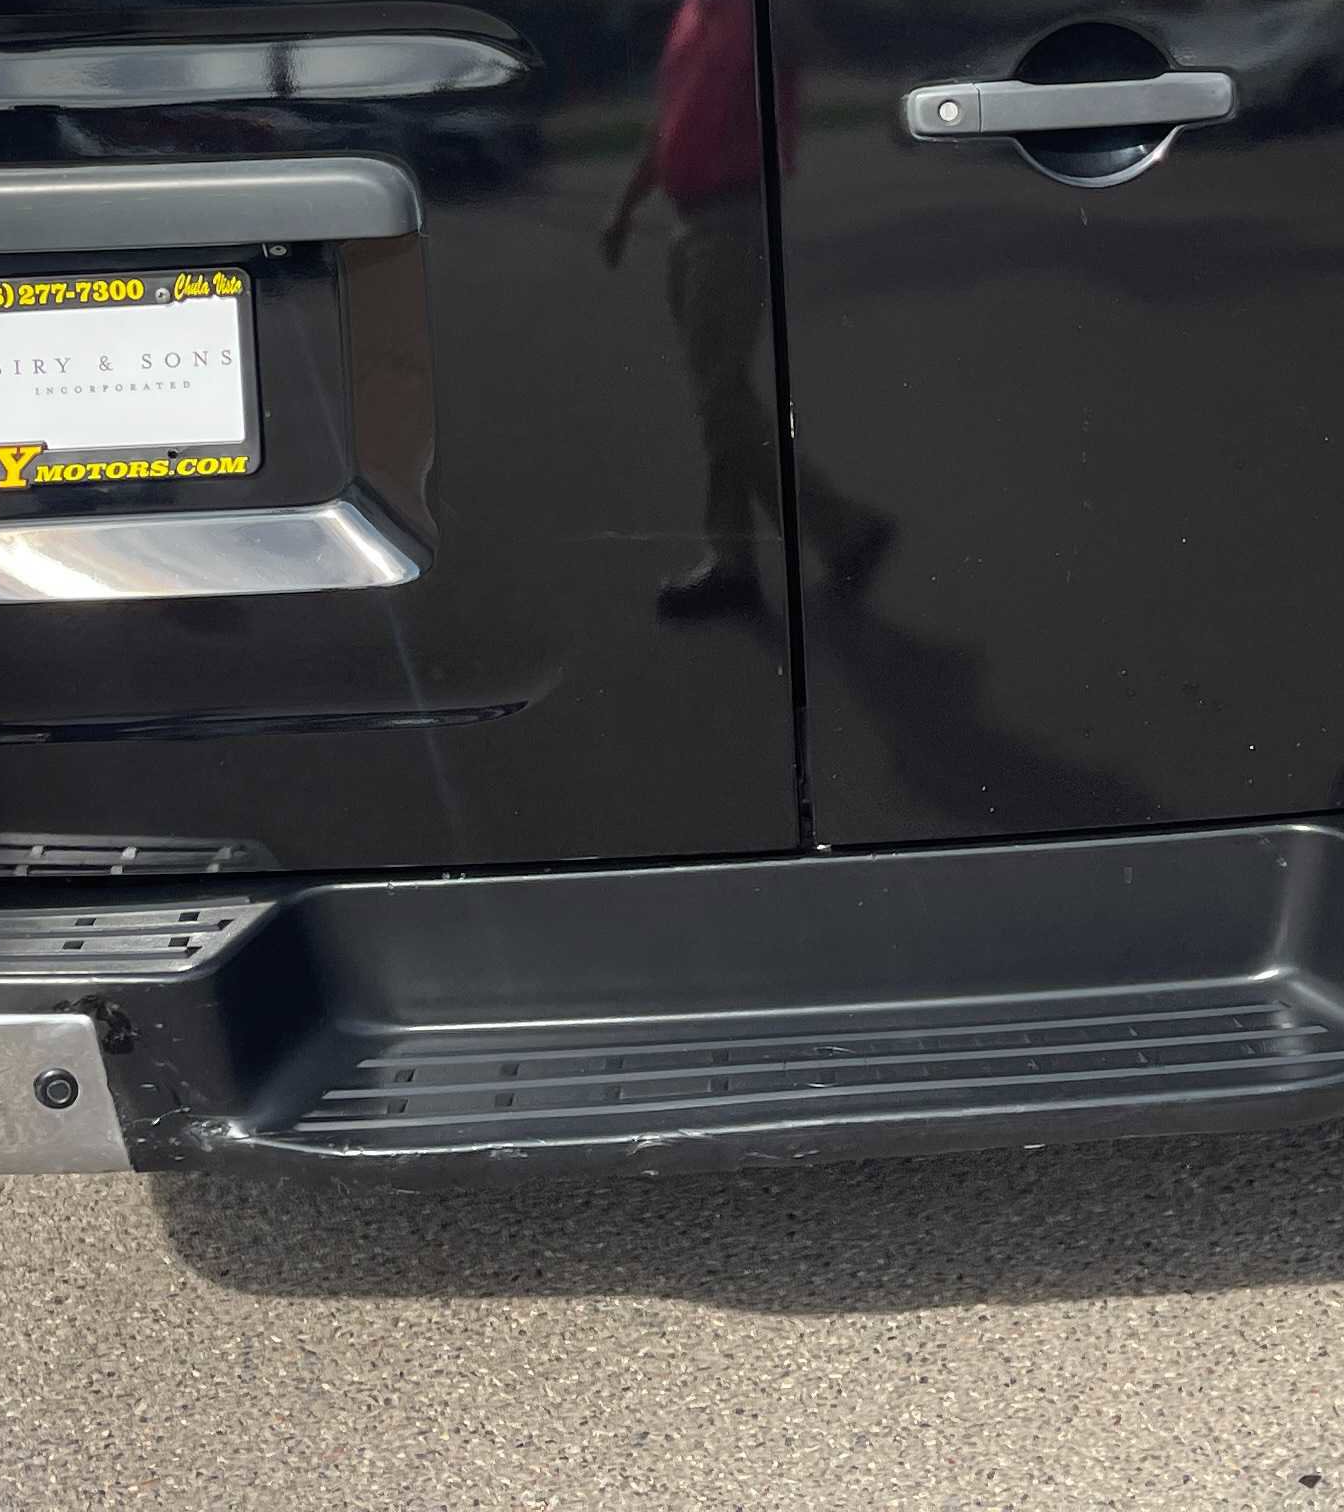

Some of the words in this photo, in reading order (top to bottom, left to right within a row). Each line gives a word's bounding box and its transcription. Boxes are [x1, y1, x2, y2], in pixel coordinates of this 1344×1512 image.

[18, 279, 144, 306] 277-7300
[174, 273, 210, 300] Chula
[213, 272, 243, 295] Vista
[98, 355, 115, 372] &
[141, 349, 234, 370] SONS
[34, 380, 192, 396] INCORPORATED
